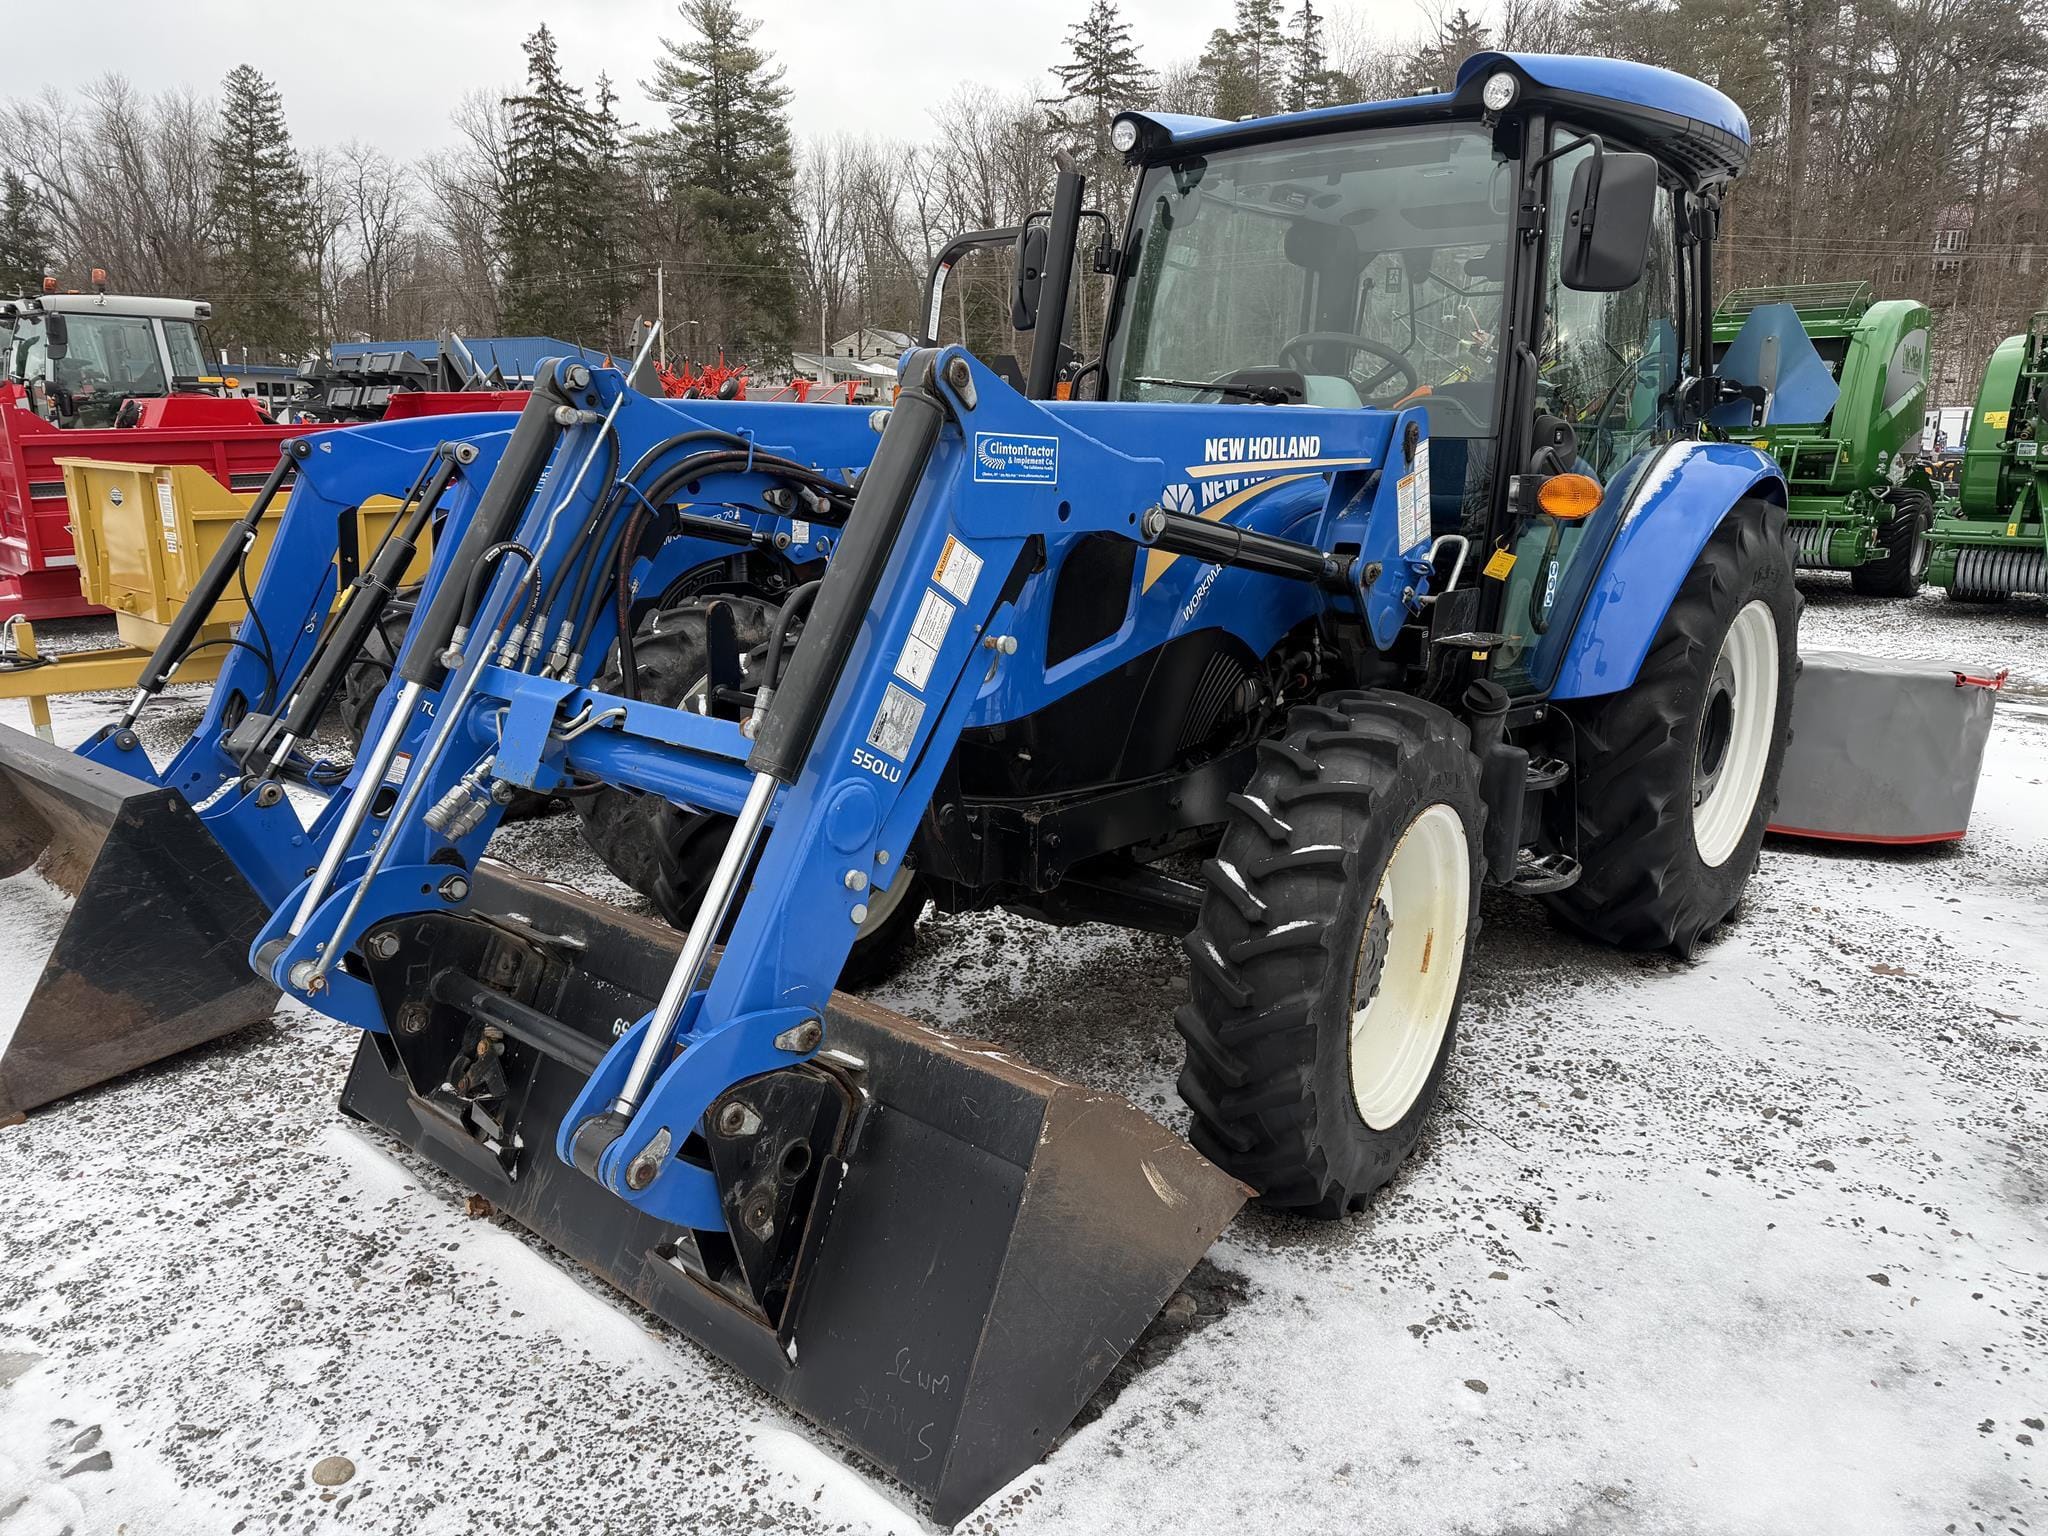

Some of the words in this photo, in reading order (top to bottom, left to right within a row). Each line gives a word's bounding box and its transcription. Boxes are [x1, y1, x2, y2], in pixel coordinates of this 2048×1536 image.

[990, 442, 1054, 457] ClintonTractor
[1204, 437, 1246, 462] NEW
[1248, 436, 1321, 460] HOLLAND
[1014, 457, 1044, 466] Implement
[1201, 479, 1239, 507] NEW
[723, 510, 734, 520] 70
[851, 747, 902, 783] 550LU
